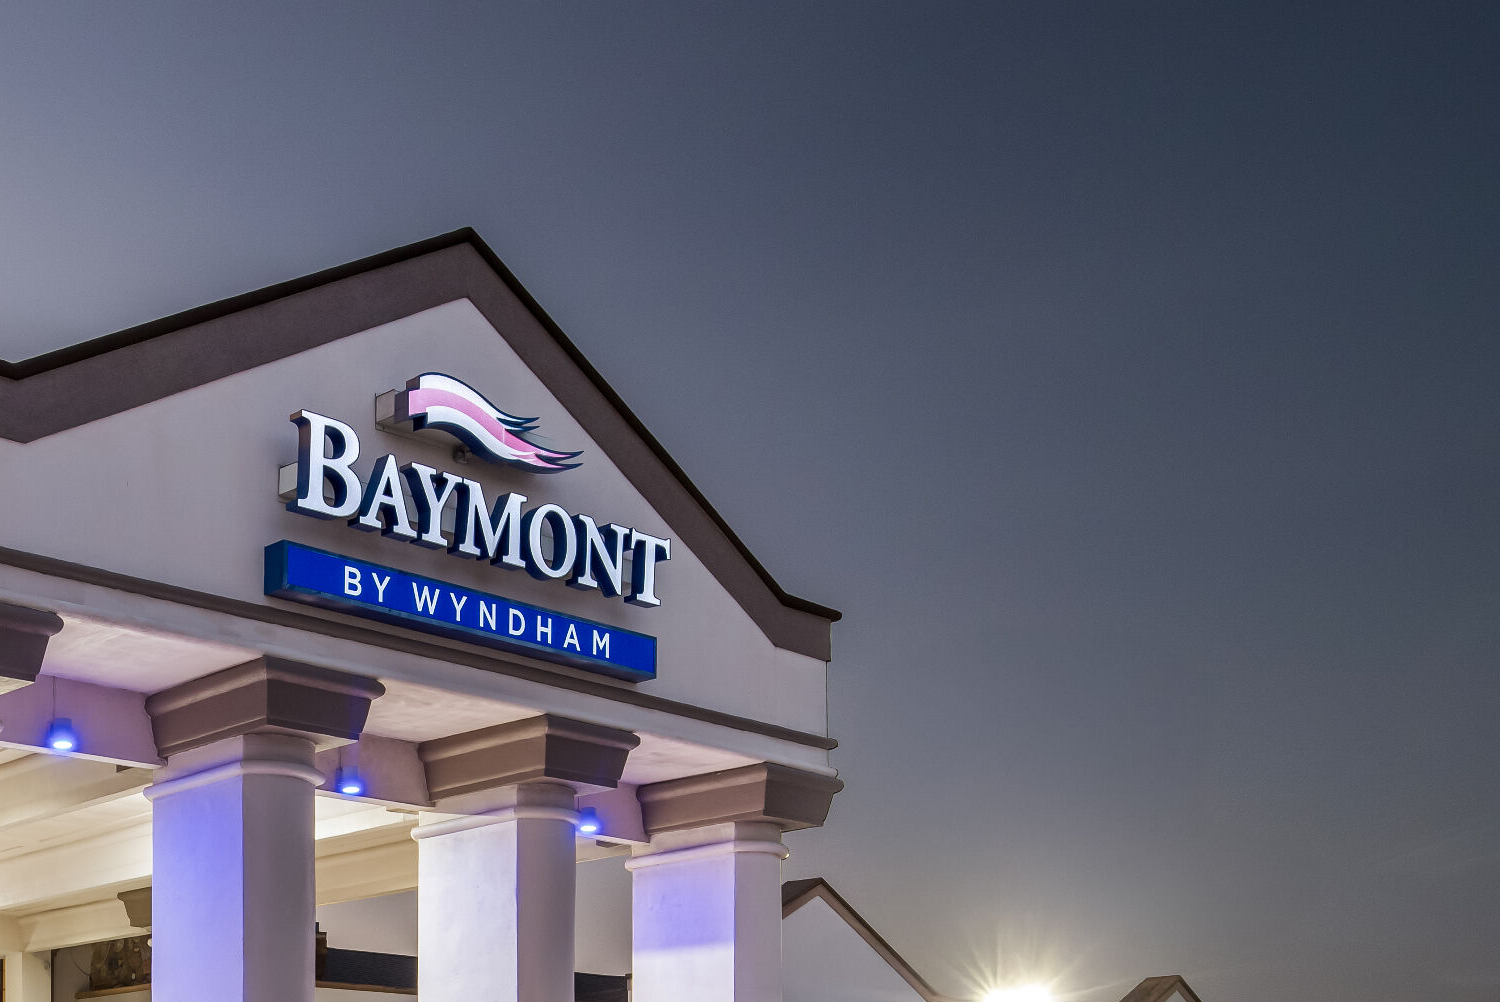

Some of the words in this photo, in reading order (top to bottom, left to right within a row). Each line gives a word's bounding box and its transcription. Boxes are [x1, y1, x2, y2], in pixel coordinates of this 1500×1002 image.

[297, 409, 671, 607] BAYMONT
[344, 565, 391, 603] BY
[412, 581, 610, 659] WYNDHAM
